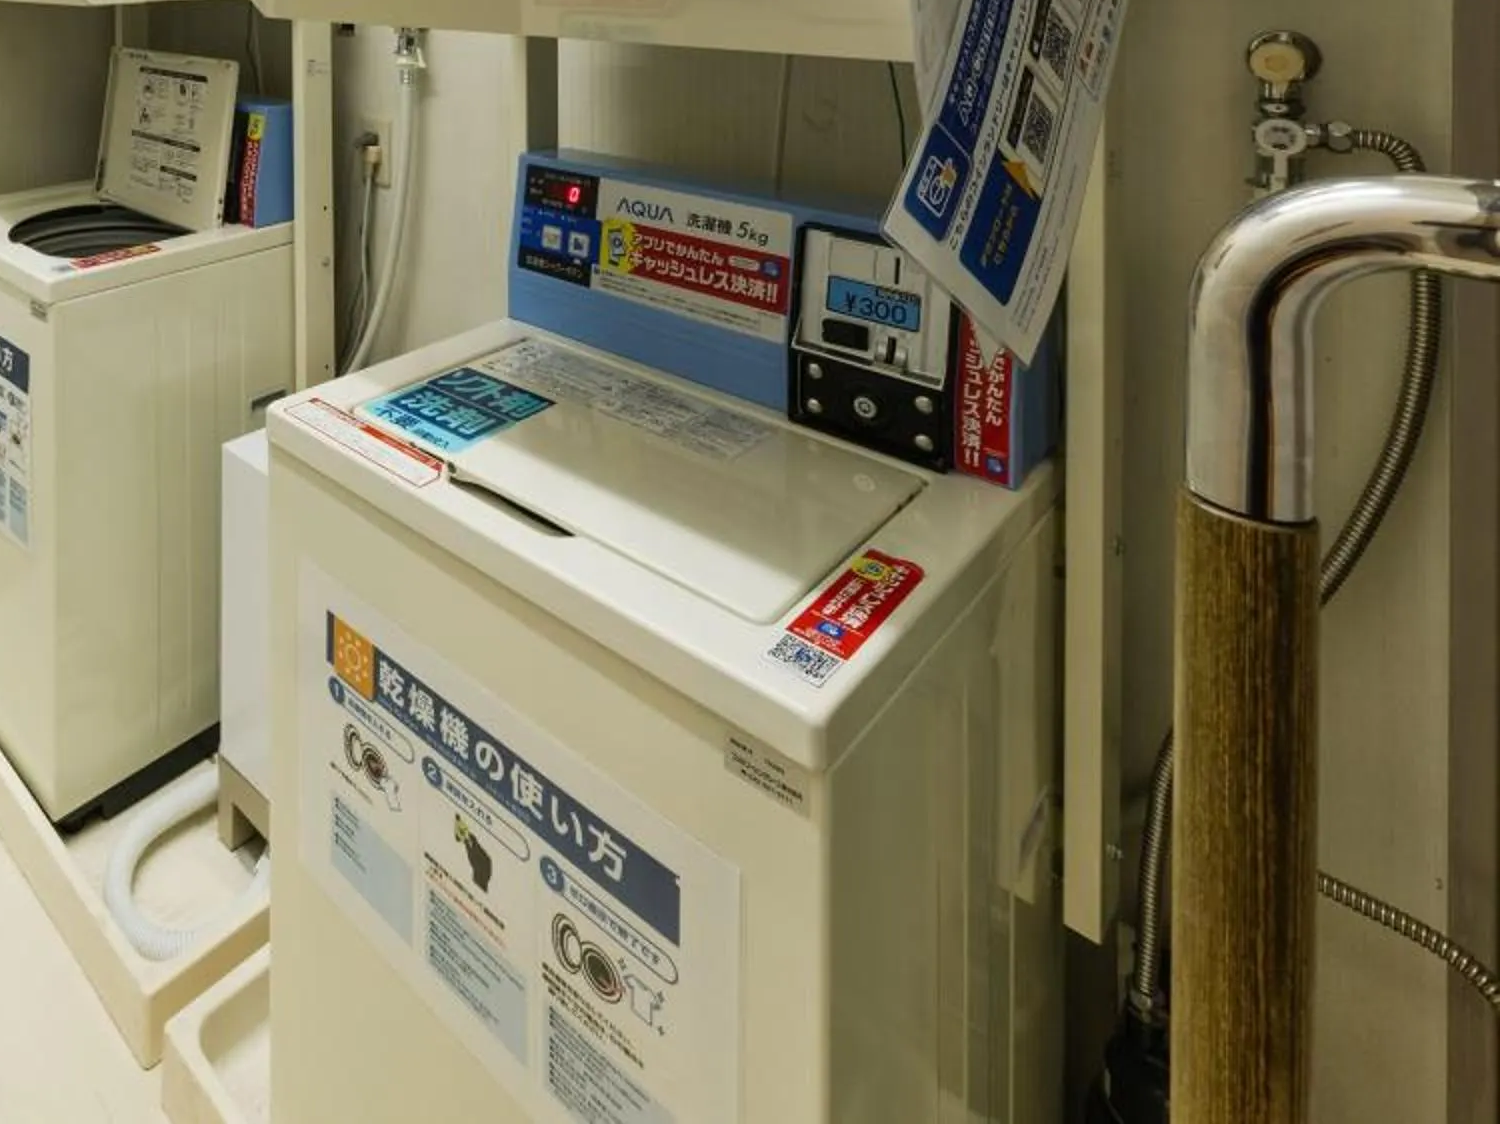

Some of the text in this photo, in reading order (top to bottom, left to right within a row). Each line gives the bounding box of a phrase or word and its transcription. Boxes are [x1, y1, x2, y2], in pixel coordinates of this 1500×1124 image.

[569, 186, 581, 204] 0
[617, 197, 769, 247] AQUA 洗濯機 5kg
[633, 231, 724, 267] アプリでかんたん
[629, 252, 778, 304] キャッシュレス決済!!
[845, 291, 907, 325] ¥300
[402, 391, 496, 435] 洗剤
[332, 680, 344, 699] 1
[378, 659, 627, 884] 乾燥機の使い方
[426, 762, 440, 783] 2
[545, 863, 560, 892] 3
